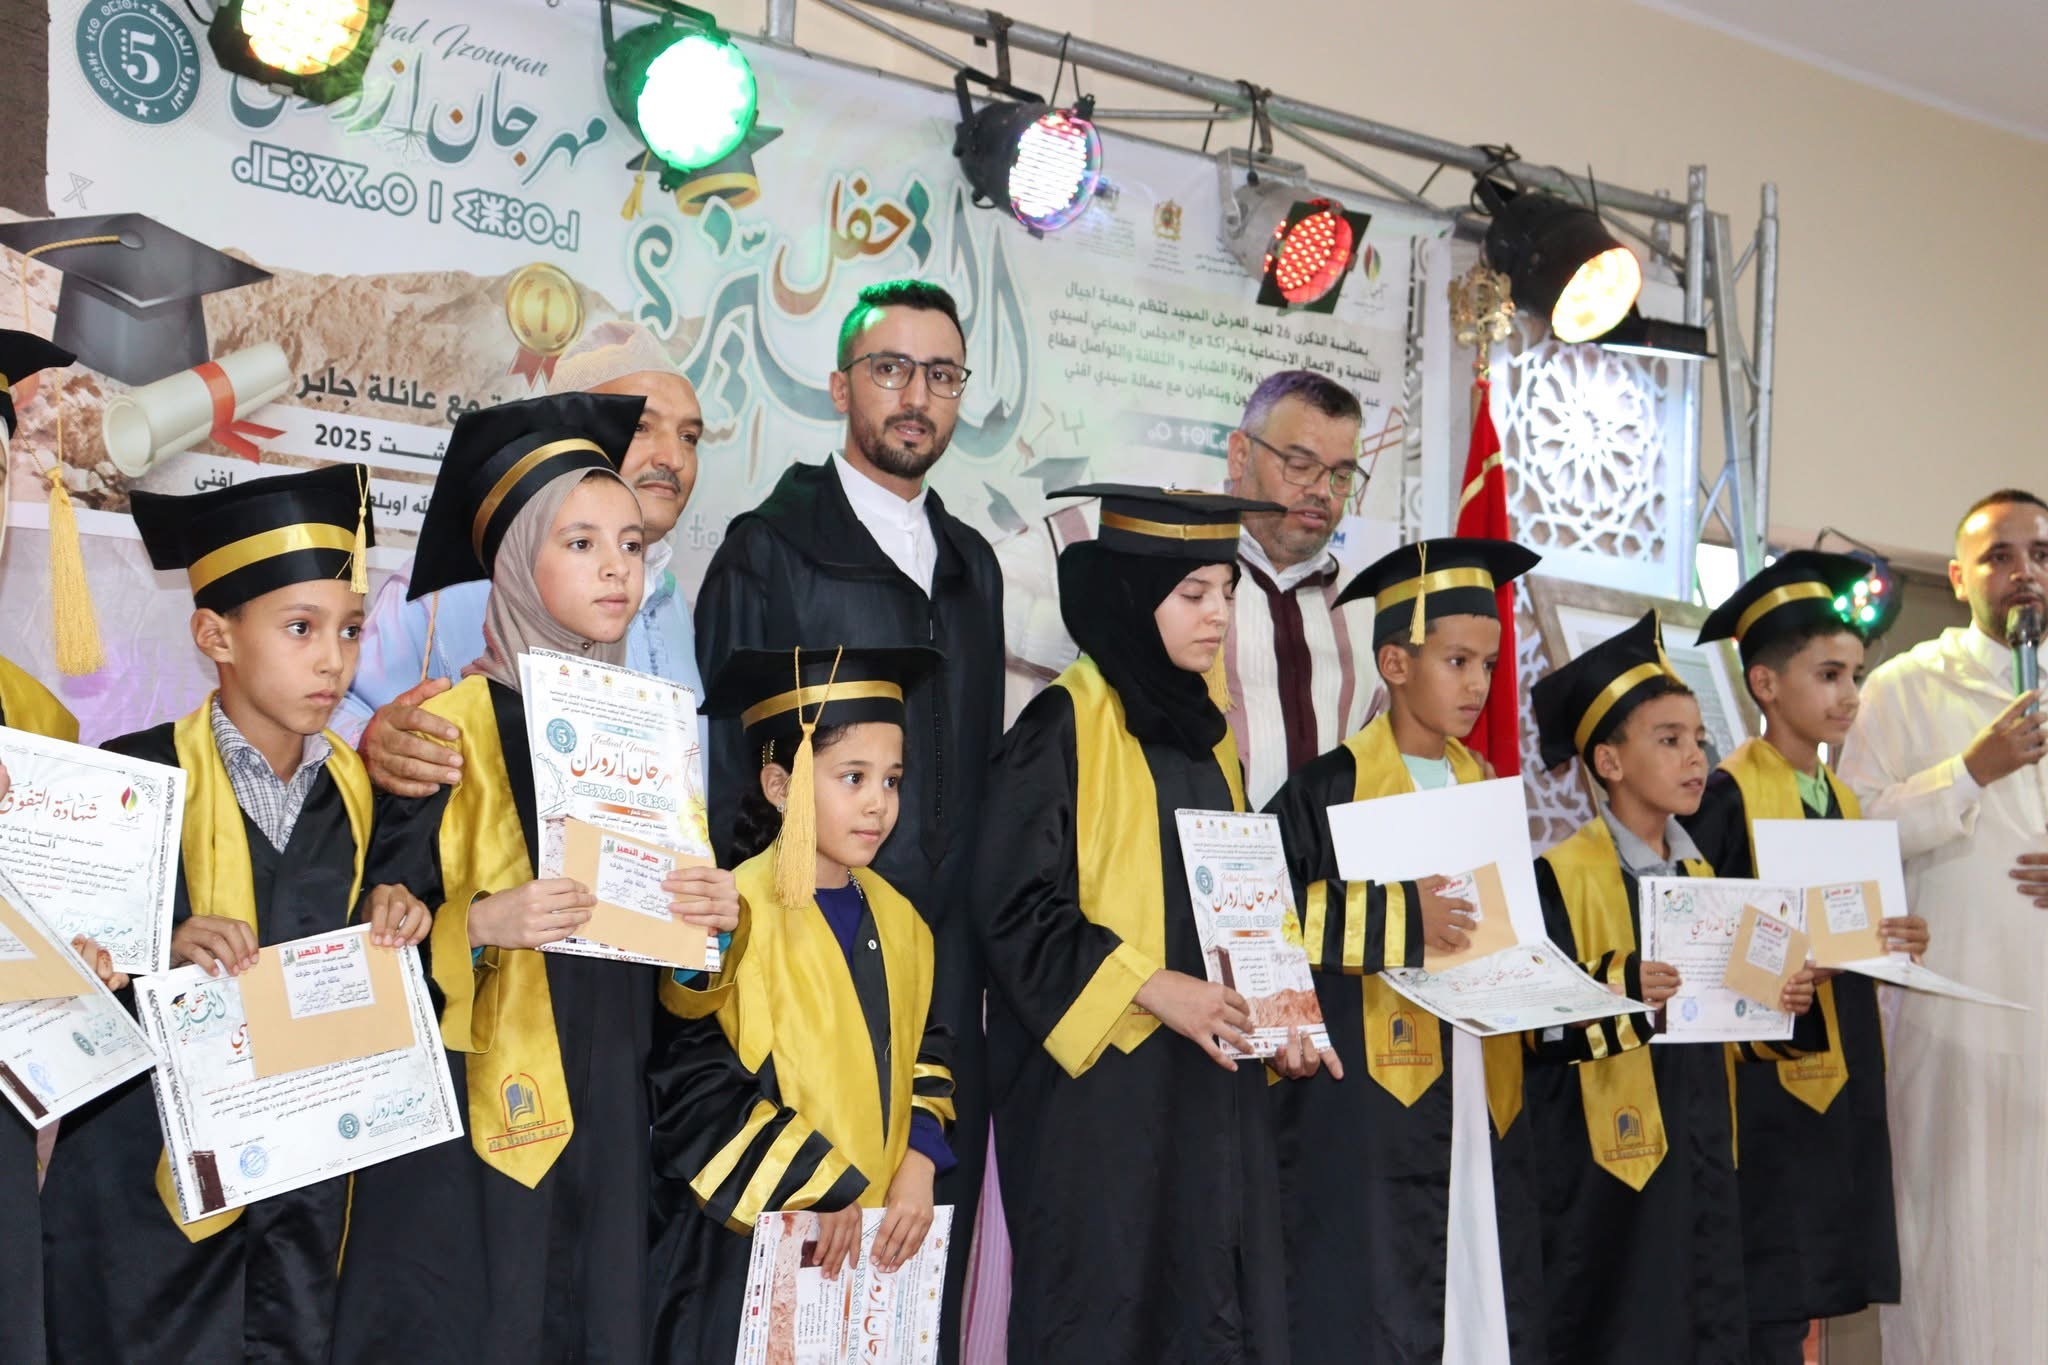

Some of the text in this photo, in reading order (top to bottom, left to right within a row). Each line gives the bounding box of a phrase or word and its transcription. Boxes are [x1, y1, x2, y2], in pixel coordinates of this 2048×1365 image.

[127, 31, 160, 84] 5
[432, 24, 551, 78] Izouran
[426, 70, 608, 186] مهرجان
[771, 178, 911, 318] حفل
[1276, 325, 1291, 339] 26
[296, 366, 358, 407] جابر
[367, 374, 437, 411] عائلة
[315, 424, 445, 461] شت 2025
[556, 728, 570, 743] 5
[627, 755, 673, 792] رجان
[53, 797, 98, 821] شهادة
